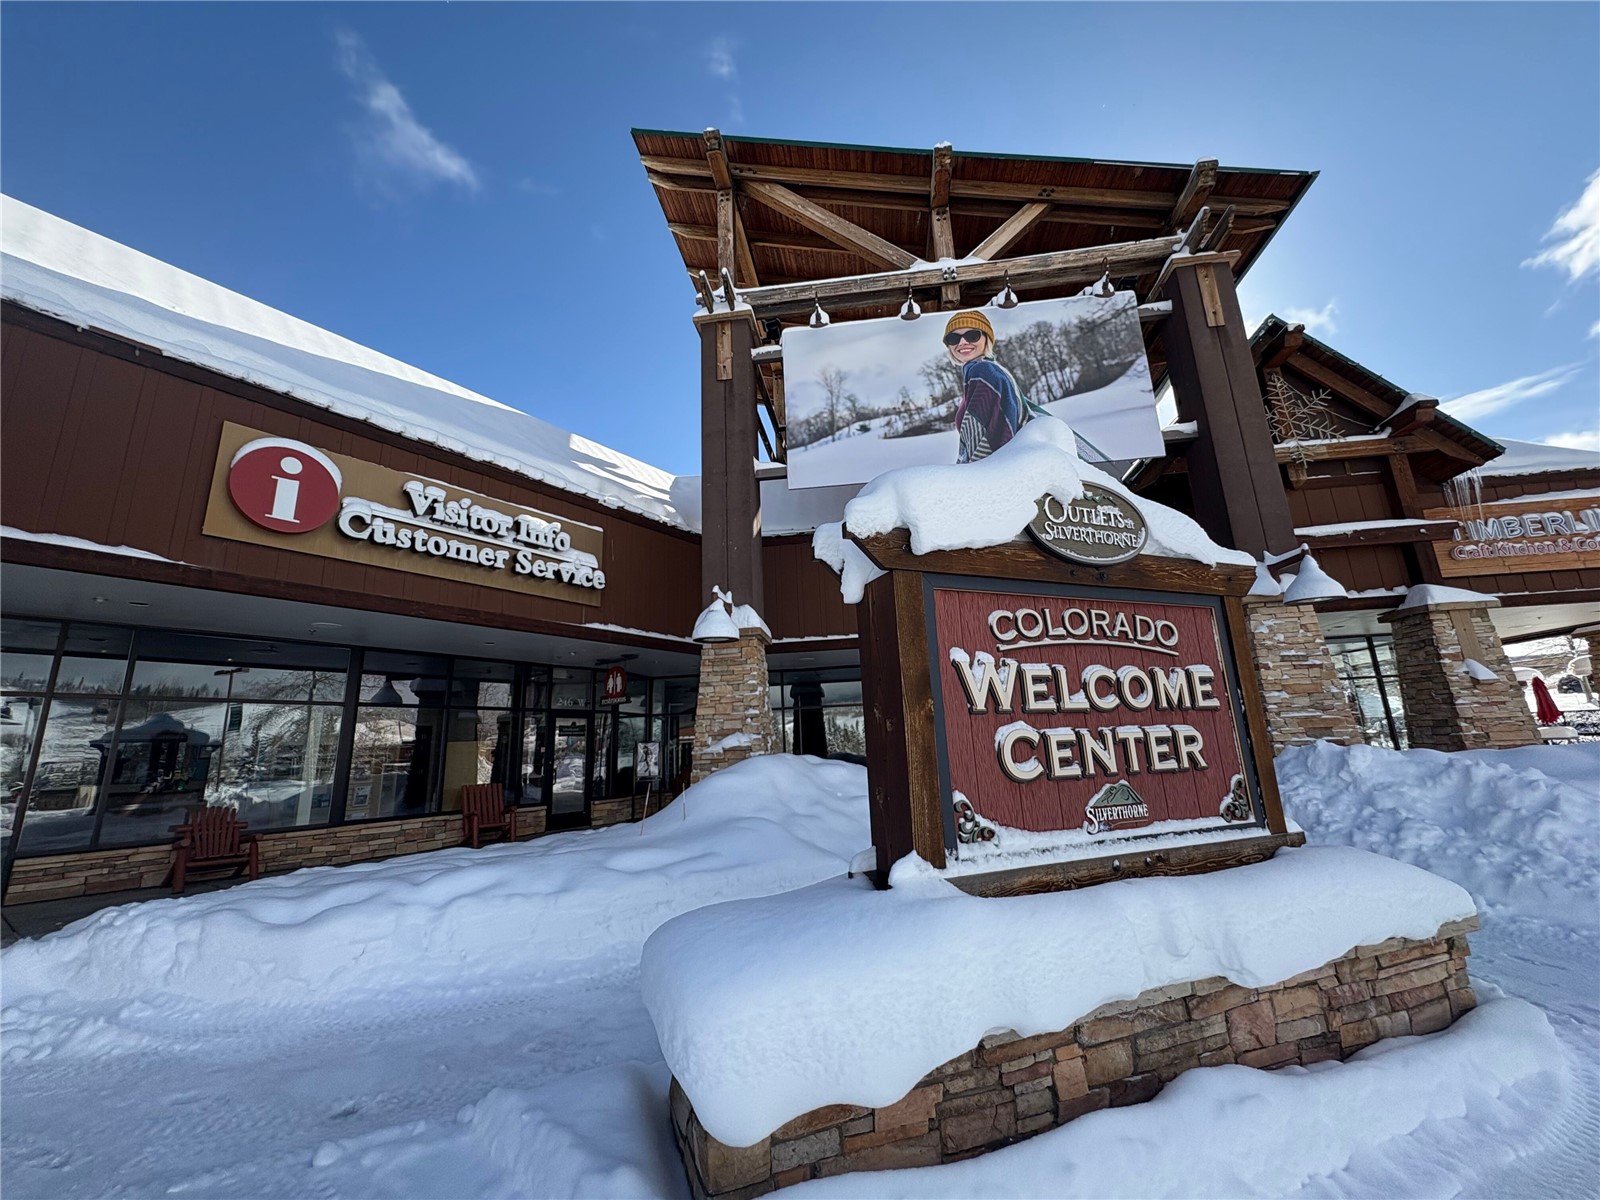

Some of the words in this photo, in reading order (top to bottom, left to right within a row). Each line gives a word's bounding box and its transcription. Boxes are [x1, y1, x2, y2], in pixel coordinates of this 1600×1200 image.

[265, 456, 303, 523] i
[403, 482, 513, 537] Visitor
[516, 515, 571, 551] Info
[1044, 495, 1125, 528] OUTLETS
[1453, 509, 1600, 542] IMBERLI
[338, 503, 509, 569] Customer
[515, 550, 606, 589] Service
[1044, 521, 1139, 549] SILVERTHORNE
[1454, 543, 1493, 559] Craft
[1496, 541, 1557, 557] Kitchen
[1560, 539, 1572, 552] &
[1575, 537, 1600, 551] Co
[988, 607, 1179, 647] COLORADO
[950, 649, 1220, 714] WELCOME
[995, 723, 1209, 783] CENTER
[1086, 804, 1149, 835] SILVERTHORNE
